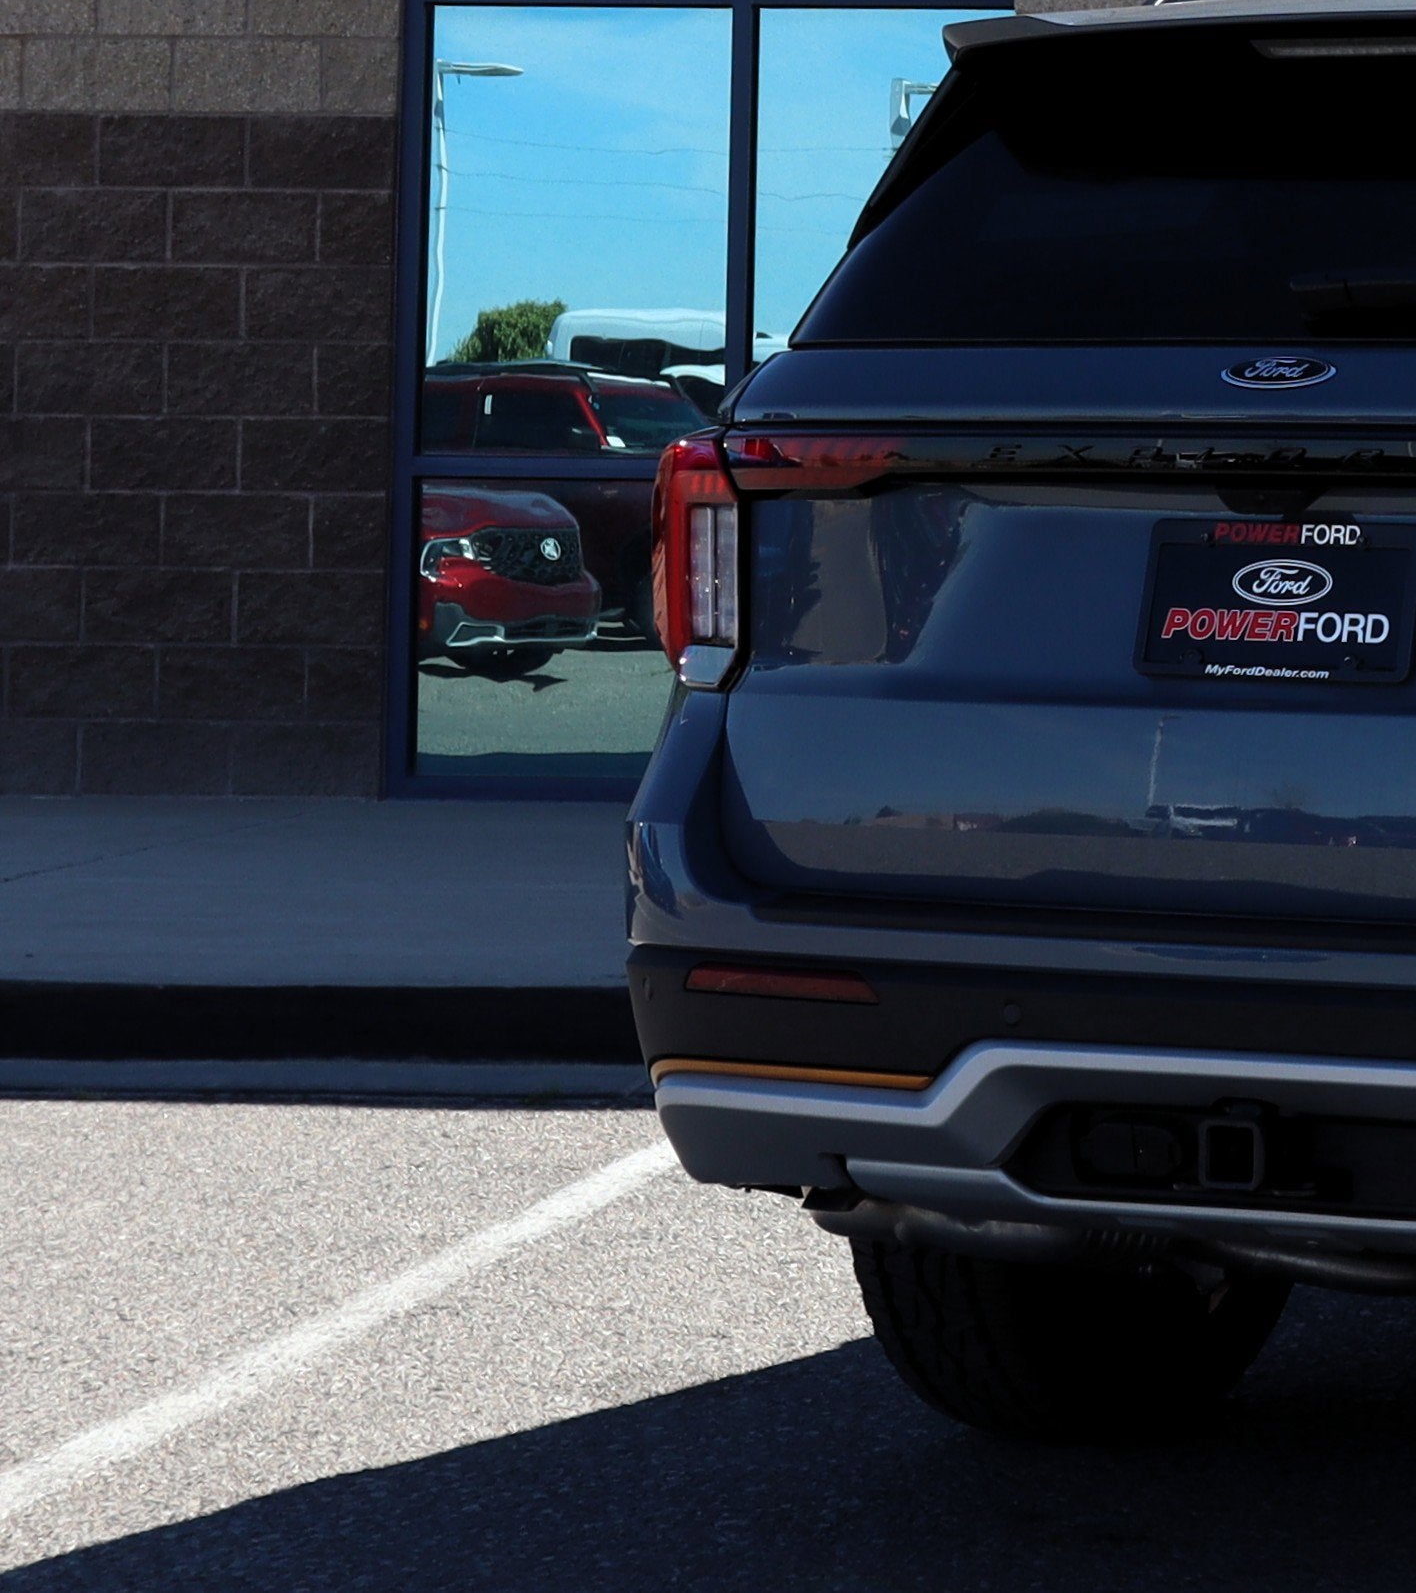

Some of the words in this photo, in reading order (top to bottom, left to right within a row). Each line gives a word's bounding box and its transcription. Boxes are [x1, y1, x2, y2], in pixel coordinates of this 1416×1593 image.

[1244, 358, 1310, 378] Ford
[1213, 522, 1361, 546] POWERFORD
[1252, 567, 1311, 595] Ford
[1161, 608, 1390, 643] POWERFORD
[1204, 663, 1330, 680] MyFordDealer.com
